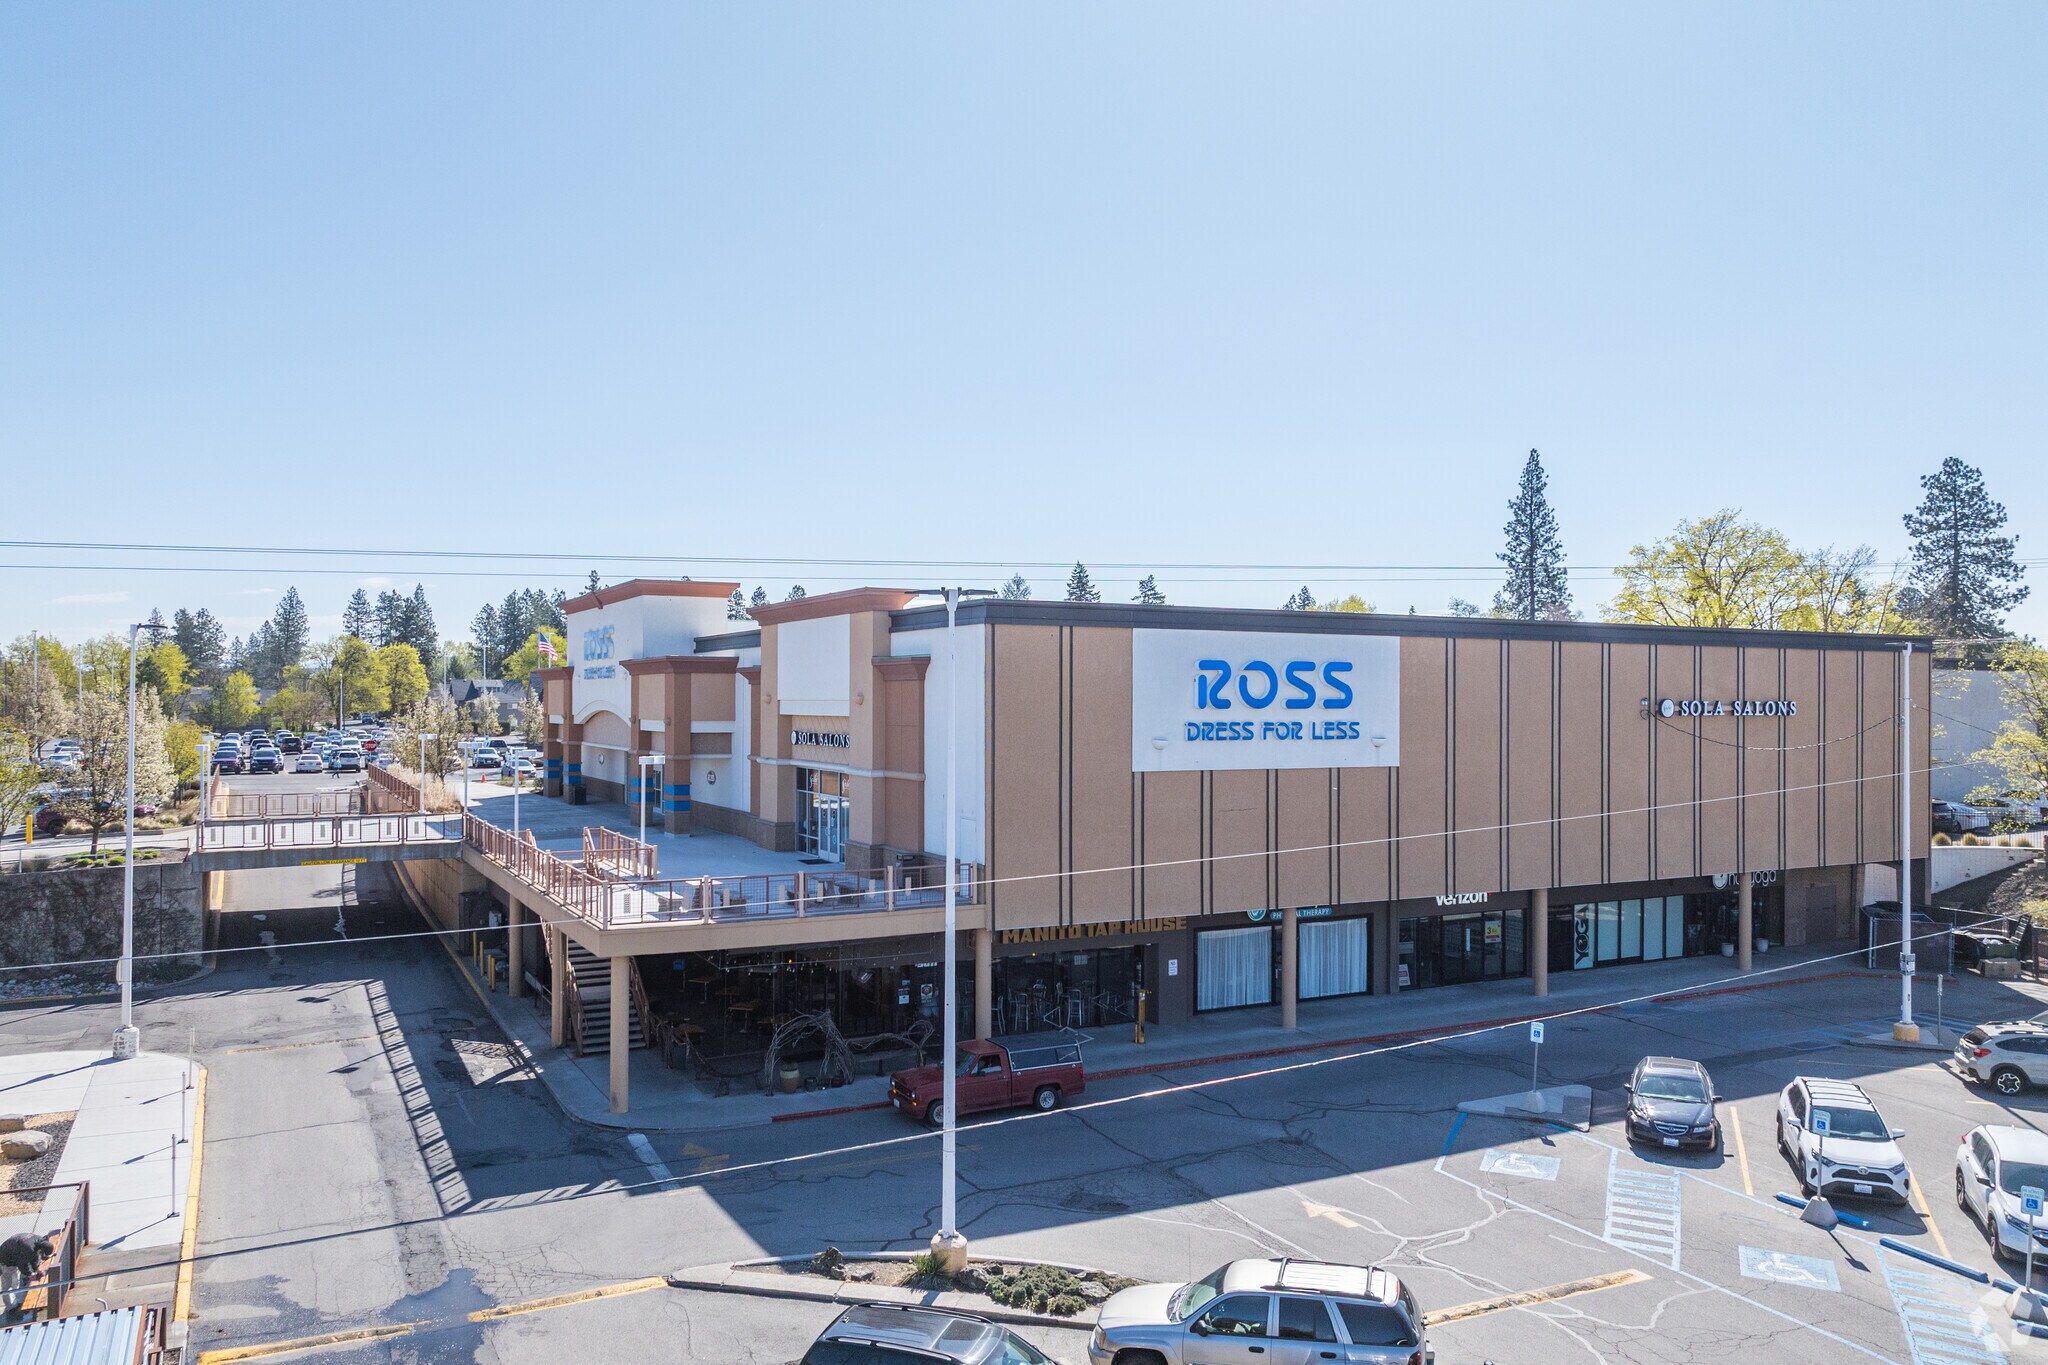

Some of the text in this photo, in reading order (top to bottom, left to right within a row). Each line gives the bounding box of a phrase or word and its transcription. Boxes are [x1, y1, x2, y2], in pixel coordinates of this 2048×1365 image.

[1196, 659, 1354, 710] ROSS
[1681, 700, 1725, 716] SOLA
[1733, 700, 1797, 716] SALONS
[798, 732, 850, 748] SOLA SALONS
[1186, 721, 1360, 742] DRESS FOR LESS
[1303, 908, 1329, 917] THERAPY
[1002, 916, 1187, 945] MANITO TAP HOUSE
[1575, 904, 1589, 966] YOGA
